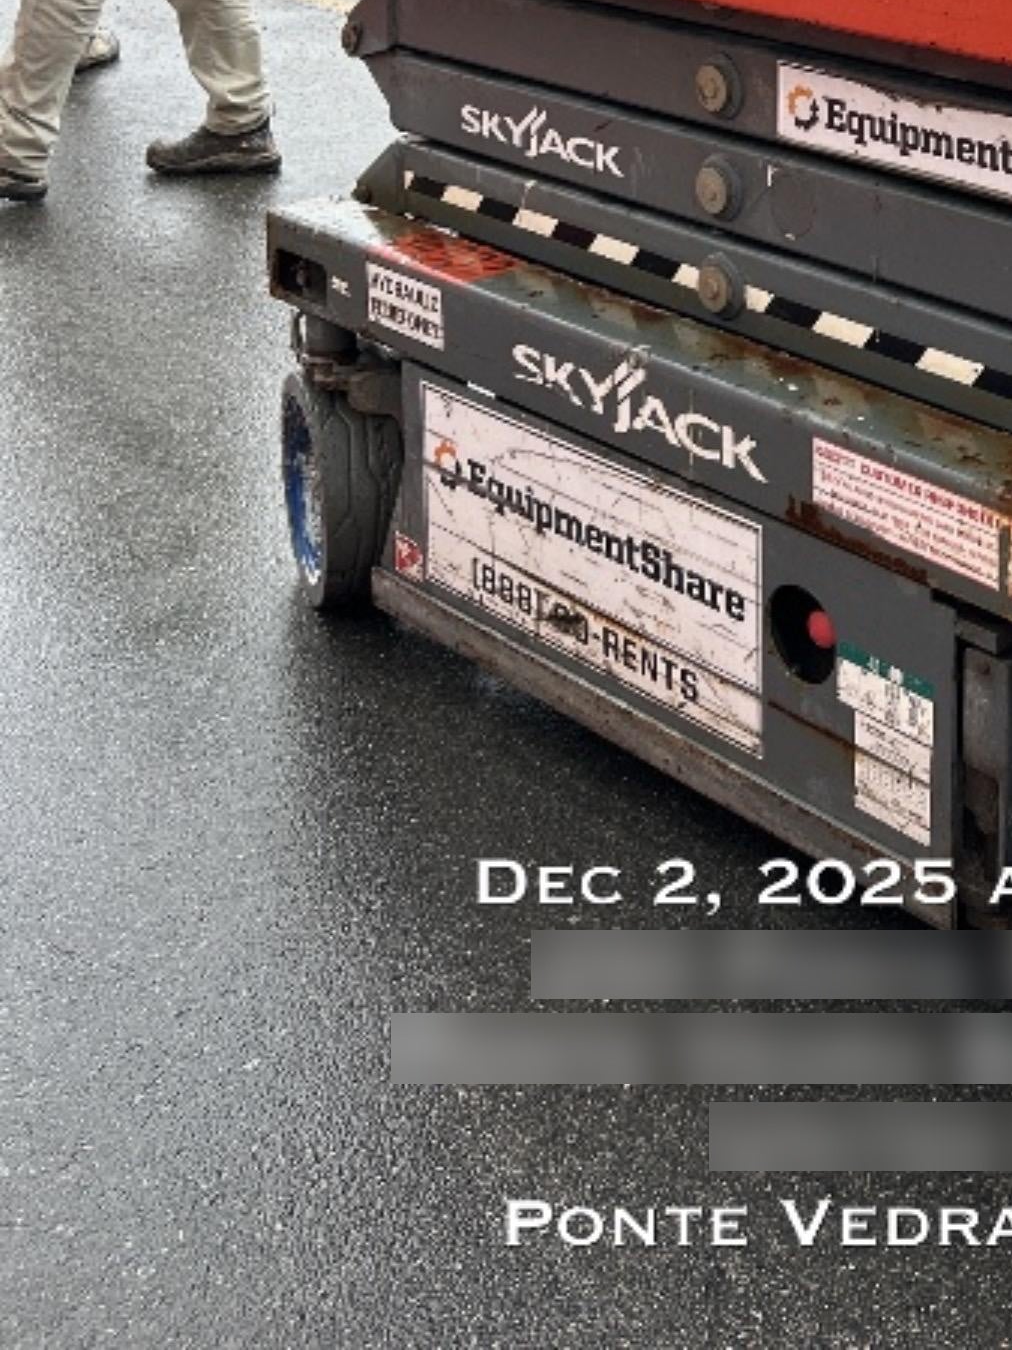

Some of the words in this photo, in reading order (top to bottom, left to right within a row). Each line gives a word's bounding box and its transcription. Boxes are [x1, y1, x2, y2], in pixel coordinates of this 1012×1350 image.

[460, 103, 625, 178] SKYJACK
[512, 344, 769, 484] SKYJACK
[467, 458, 746, 622] EquipmentShare
